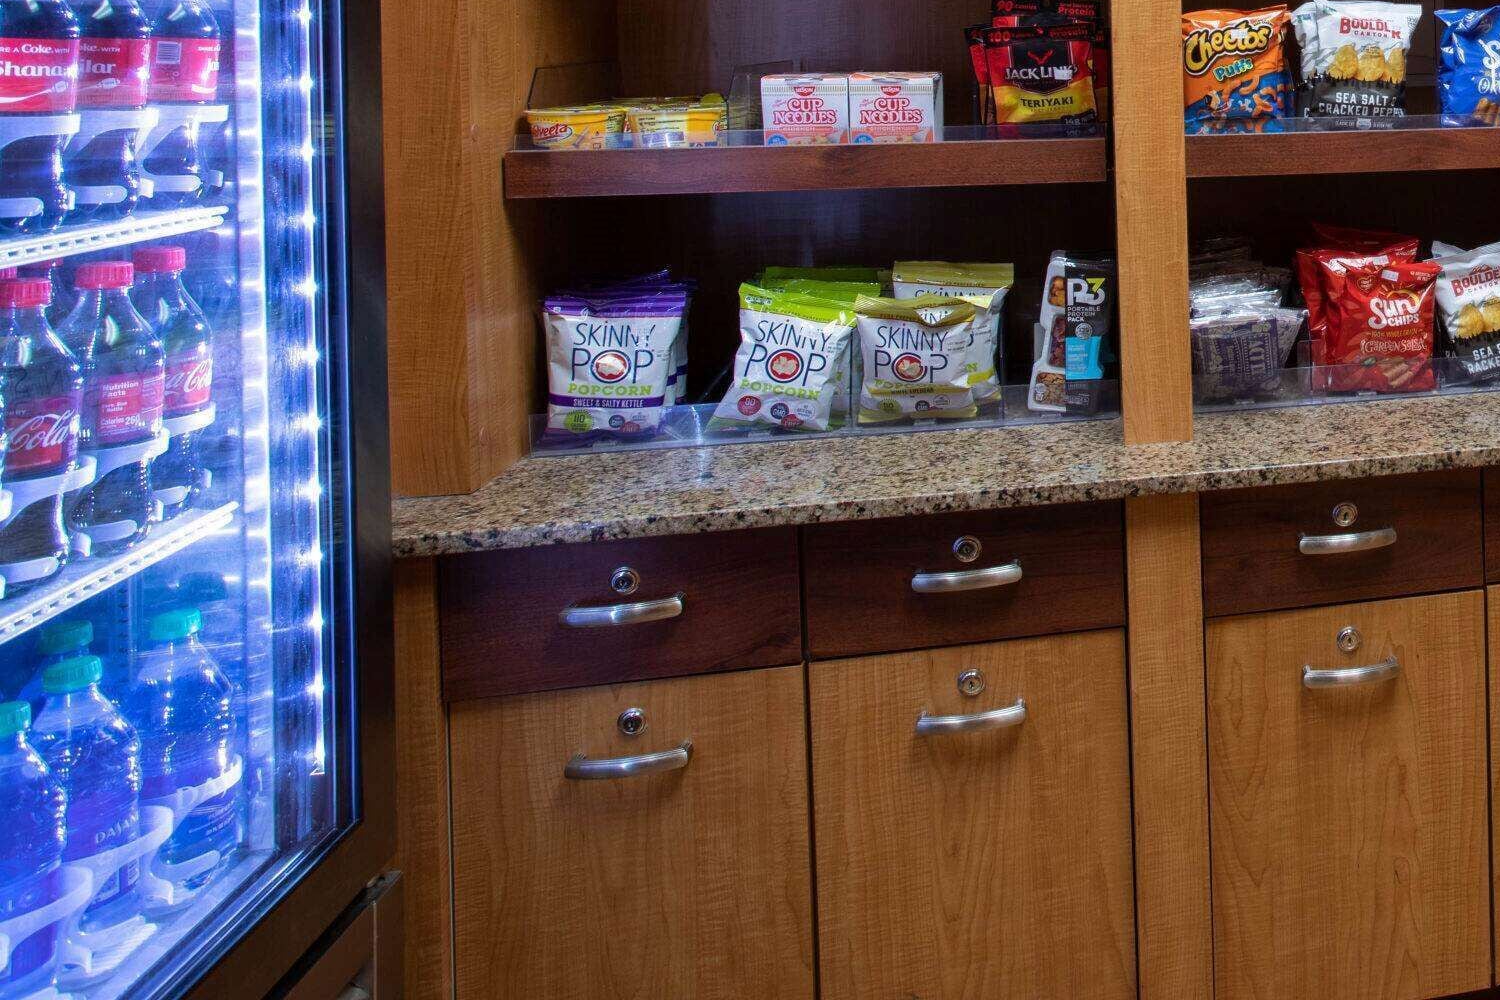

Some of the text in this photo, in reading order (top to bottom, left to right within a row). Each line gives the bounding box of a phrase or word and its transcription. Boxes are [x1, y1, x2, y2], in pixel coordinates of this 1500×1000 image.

[1339, 16, 1402, 40] BOULD
[1353, 30, 1388, 38] CANYON
[21, 43, 53, 54] Coke
[1185, 21, 1272, 74] Cheetos
[1005, 67, 1040, 80] JACK
[1213, 58, 1254, 81] Puffs
[787, 98, 824, 112] CUP
[874, 98, 911, 112] CUP
[1020, 96, 1074, 108] TERIYAKI
[1335, 93, 1389, 105] SEA SALT
[773, 109, 837, 125] NOODLES
[860, 109, 923, 125] NOODLES
[1318, 103, 1368, 116] CRACKED
[1368, 296, 1421, 329] Sun
[1388, 313, 1420, 327] CHIPS
[875, 323, 949, 351] SKINNY
[1472, 346, 1495, 362] SEA
[571, 347, 655, 384] POP
[744, 343, 827, 386] POP
[874, 350, 949, 383] POP
[102, 381, 138, 392] Nutrition
[568, 384, 652, 396] POPCORN
[740, 379, 820, 400] POPCORN
[573, 399, 594, 407] SWEET
[602, 400, 619, 408] SALTY
[621, 400, 644, 408] KETTLE
